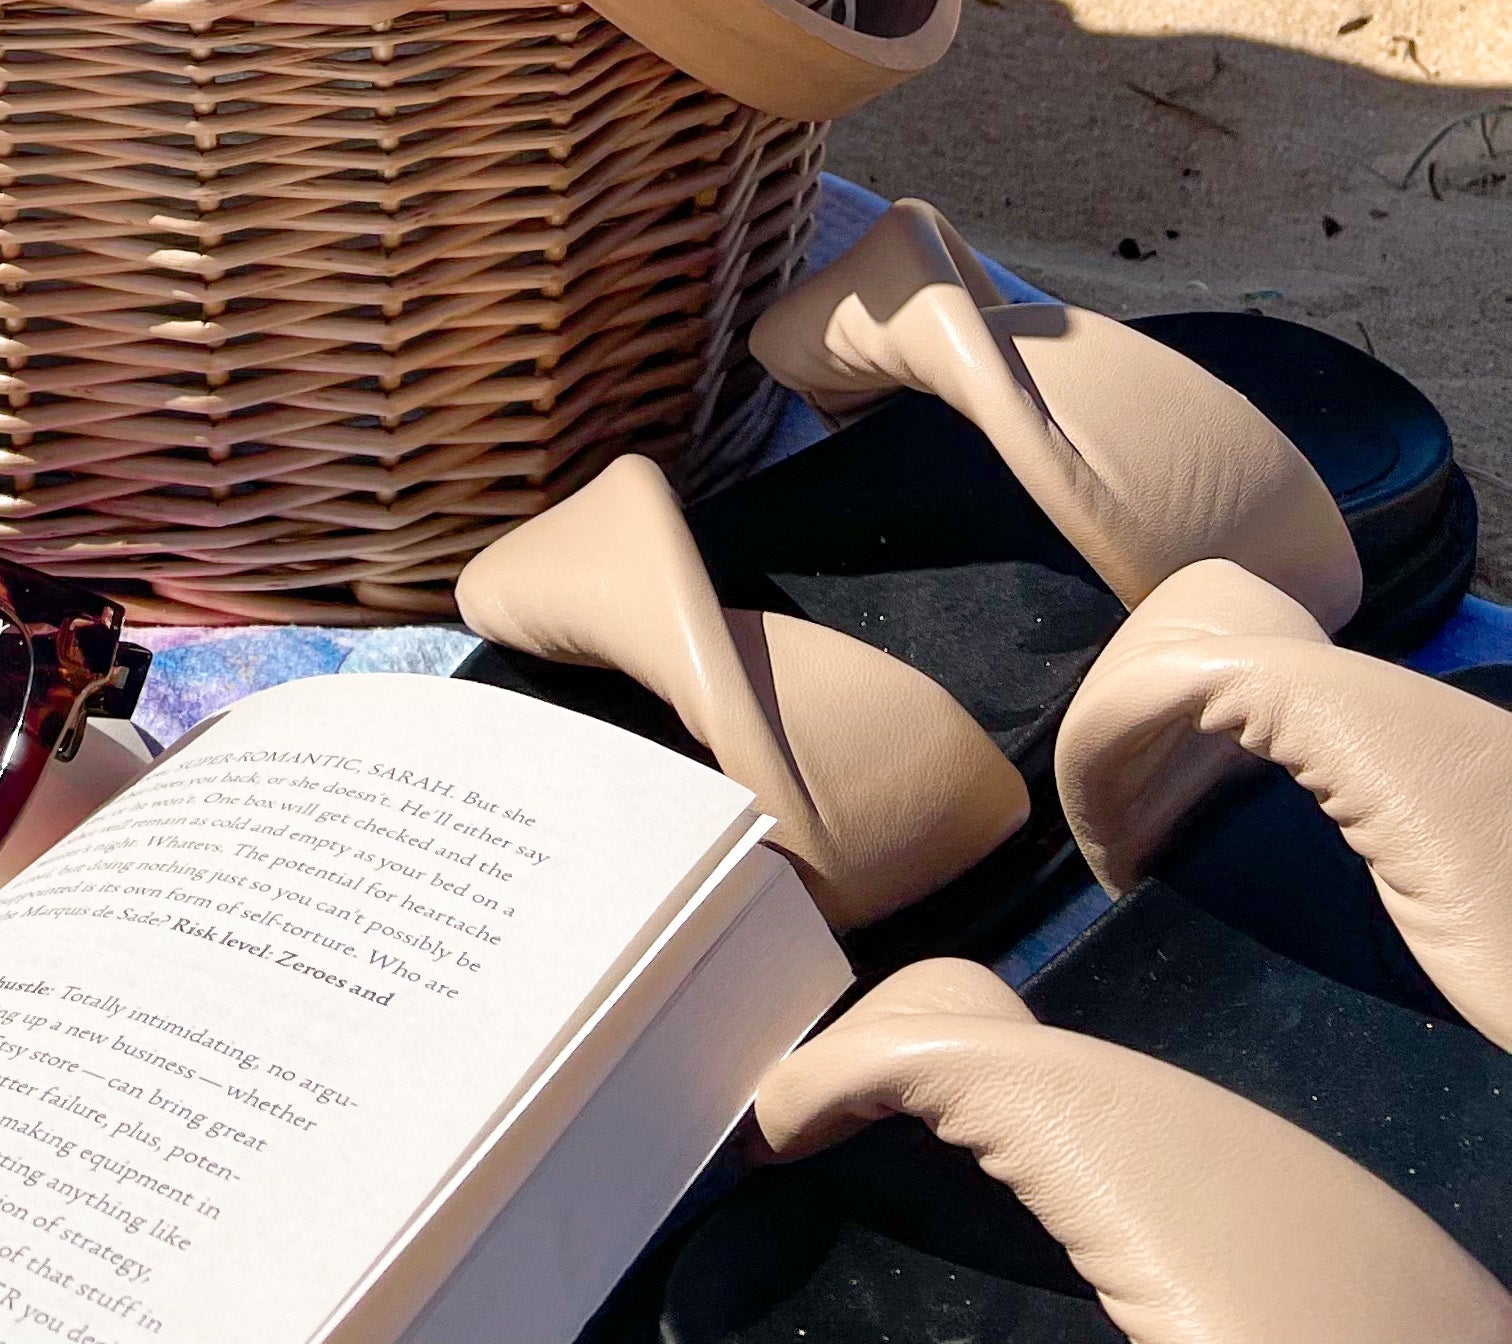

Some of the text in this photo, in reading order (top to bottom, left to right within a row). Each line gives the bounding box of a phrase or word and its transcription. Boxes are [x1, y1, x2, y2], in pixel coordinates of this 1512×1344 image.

[367, 763, 536, 827] SARAH. But she
[280, 802, 513, 882] will get checked and the
[136, 860, 209, 881] nothing
[206, 871, 248, 886] just
[248, 881, 272, 892] so
[270, 887, 312, 907] you
[362, 920, 453, 962] possibly
[455, 951, 481, 972] be
[234, 843, 269, 862] The
[267, 856, 365, 890] potential
[363, 881, 398, 902] for
[399, 894, 501, 946] heartache
[123, 886, 459, 999] own form of self-torture. Who are
[169, 917, 218, 941] Risk
[218, 931, 273, 959] level:
[274, 950, 347, 988] Zeroes
[348, 984, 396, 1007] and
[60, 985, 127, 1018] Totally
[127, 1009, 260, 1070] intimidating,
[266, 1063, 296, 1081] no
[298, 1078, 358, 1107] argu-
[38, 1086, 108, 1129] failure,
[109, 1121, 161, 1152] plus,
[162, 1145, 240, 1181] poten-
[45, 1177, 148, 1234] anything
[148, 1218, 191, 1251] like
[79, 1149, 194, 1206] equipment
[196, 1197, 220, 1220] in
